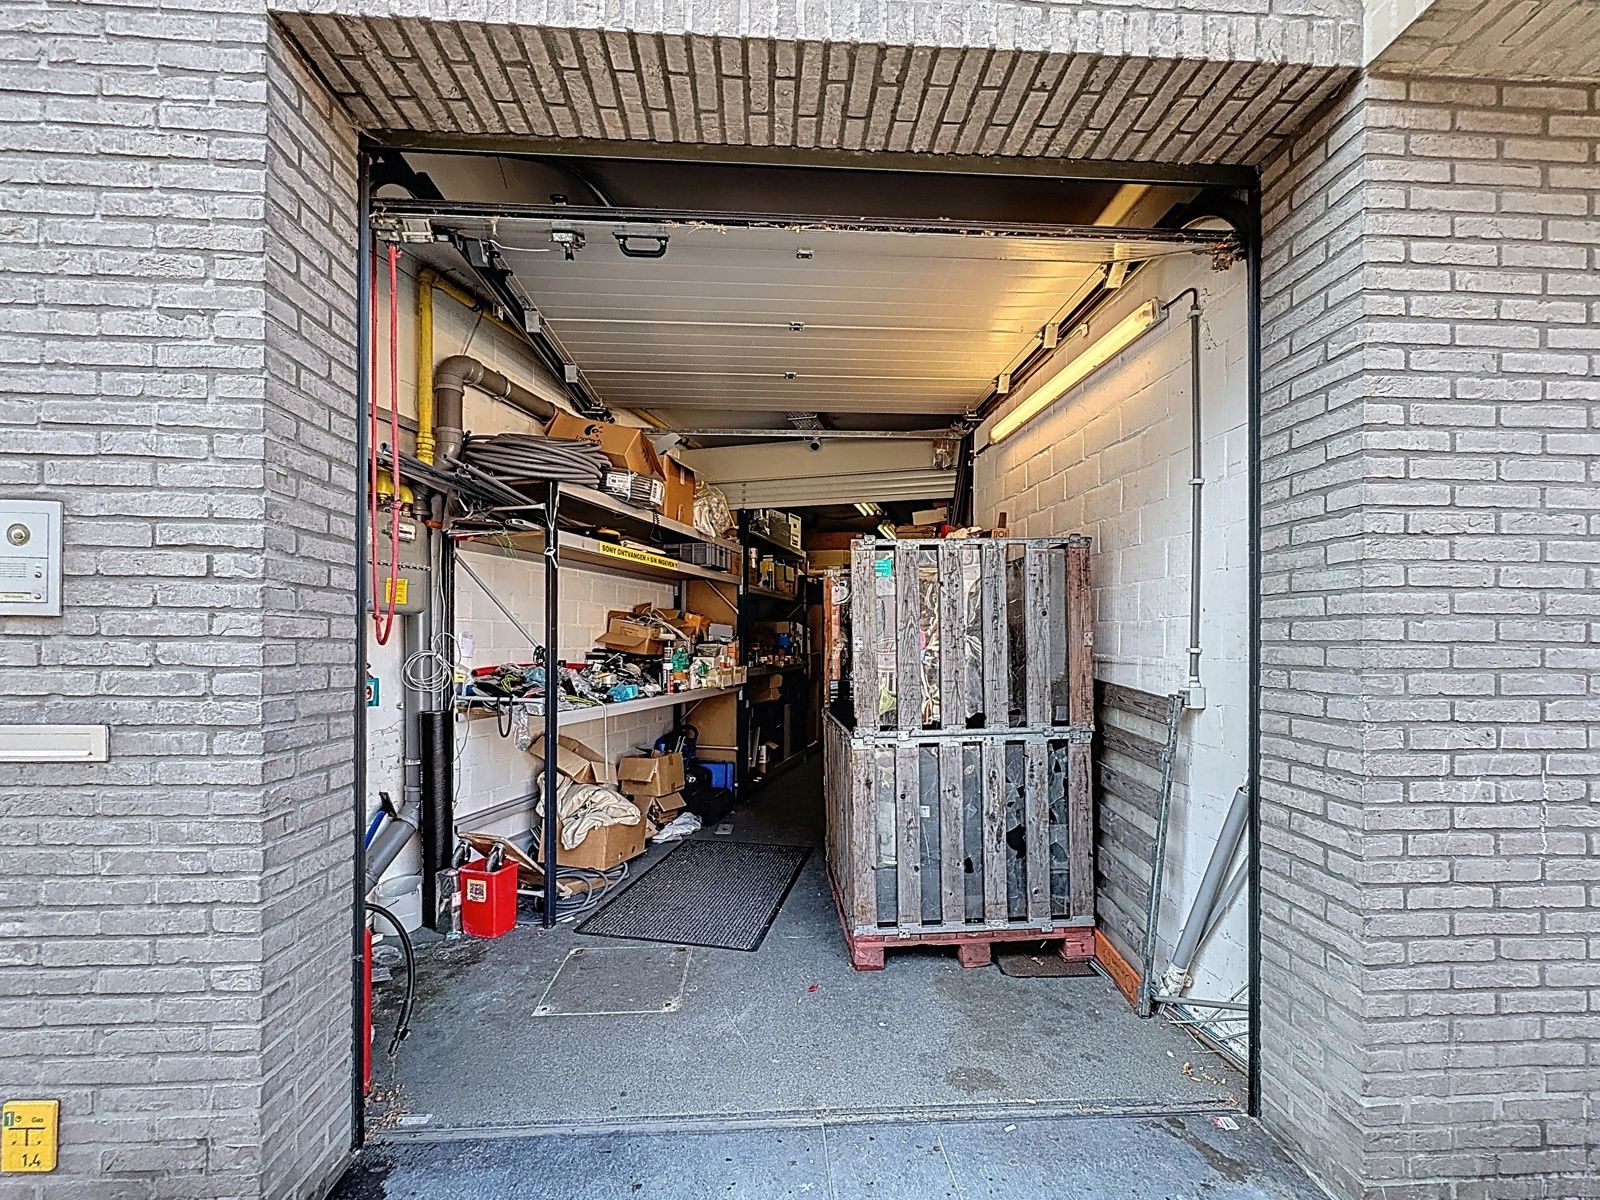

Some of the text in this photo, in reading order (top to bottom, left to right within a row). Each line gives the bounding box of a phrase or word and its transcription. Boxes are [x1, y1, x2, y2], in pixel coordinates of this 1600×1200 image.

[602, 544, 616, 555] SONY
[617, 549, 646, 561] ONTVANGEN
[22, 1153, 41, 1167] 1,4
